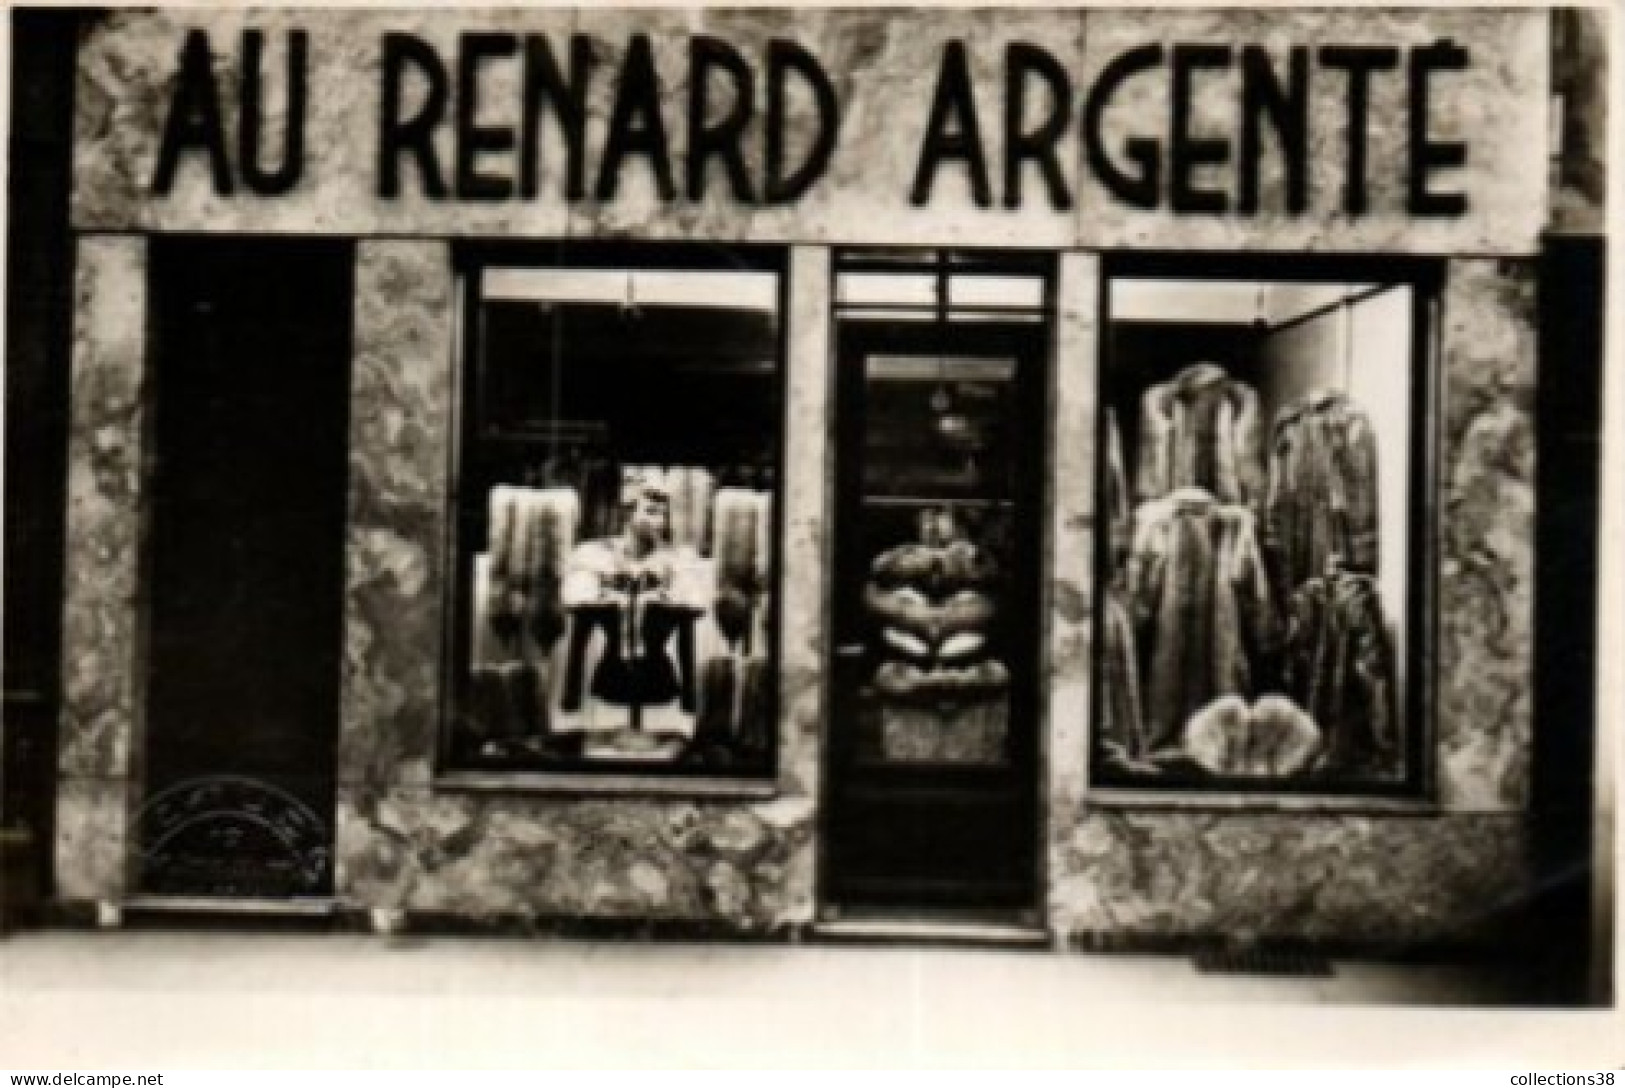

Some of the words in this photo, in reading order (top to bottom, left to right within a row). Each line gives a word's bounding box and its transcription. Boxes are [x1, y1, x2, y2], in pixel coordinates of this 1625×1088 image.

[152, 28, 310, 198] AU
[376, 31, 841, 206] RENARD
[909, 39, 1471, 218] ARGENTÉ
